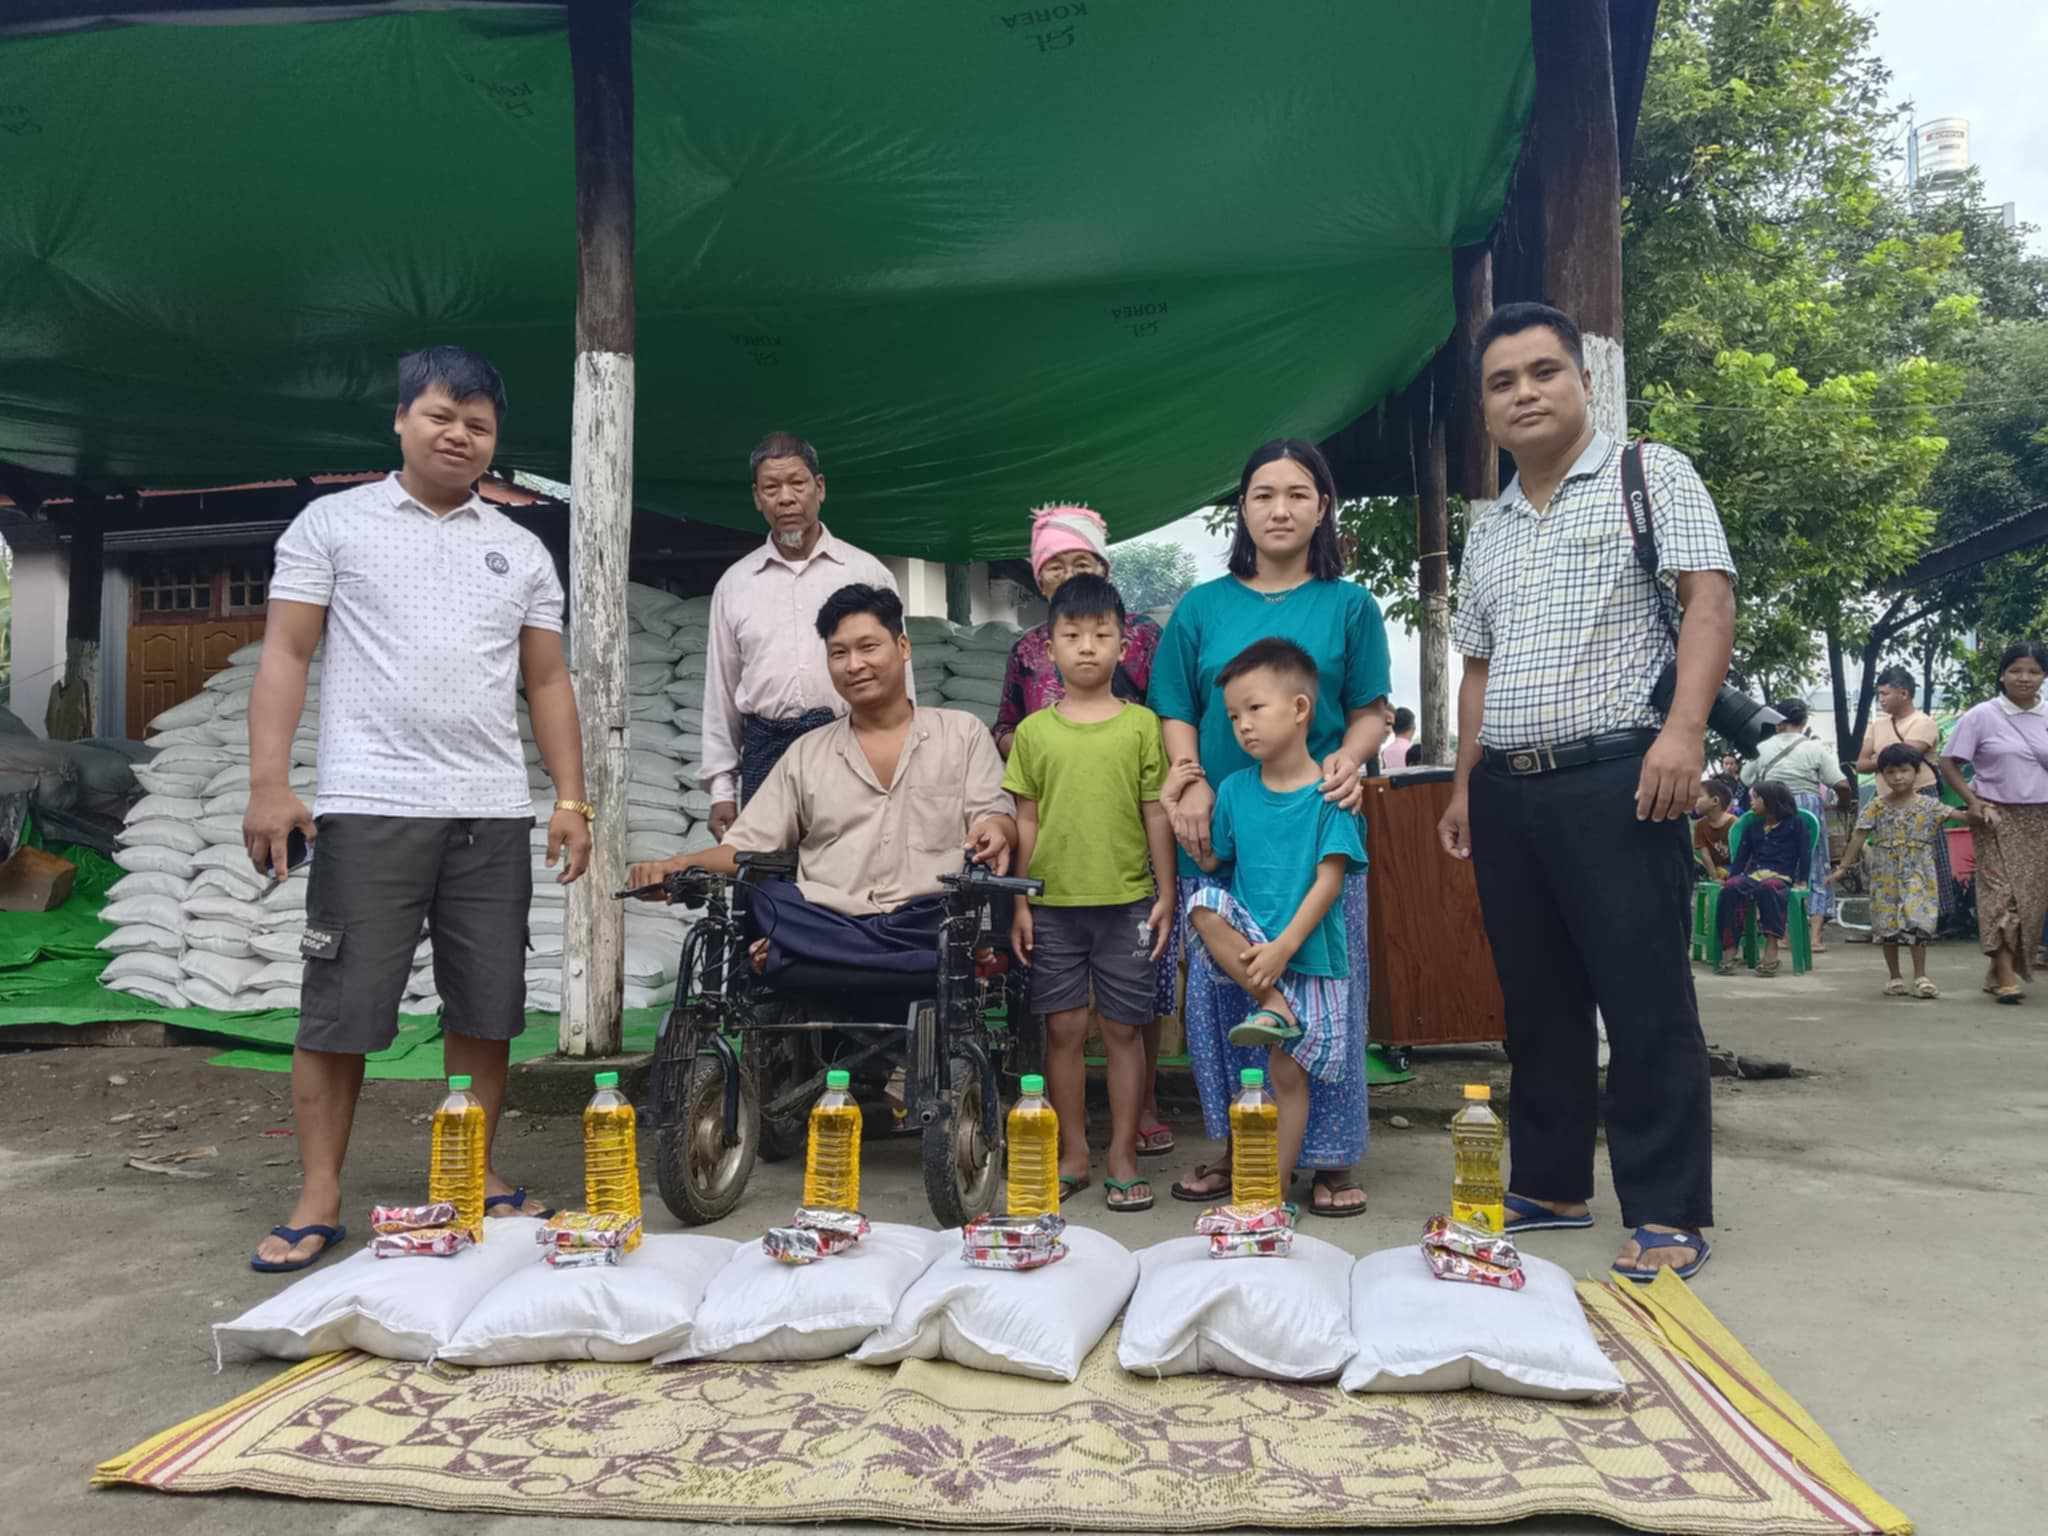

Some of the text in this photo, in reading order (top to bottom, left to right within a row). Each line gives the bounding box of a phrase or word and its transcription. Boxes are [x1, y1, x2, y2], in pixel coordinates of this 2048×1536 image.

[1000, 2, 1088, 29] KOREA
[1111, 302, 1169, 319] KOREA
[1630, 490, 1647, 533] Canon
